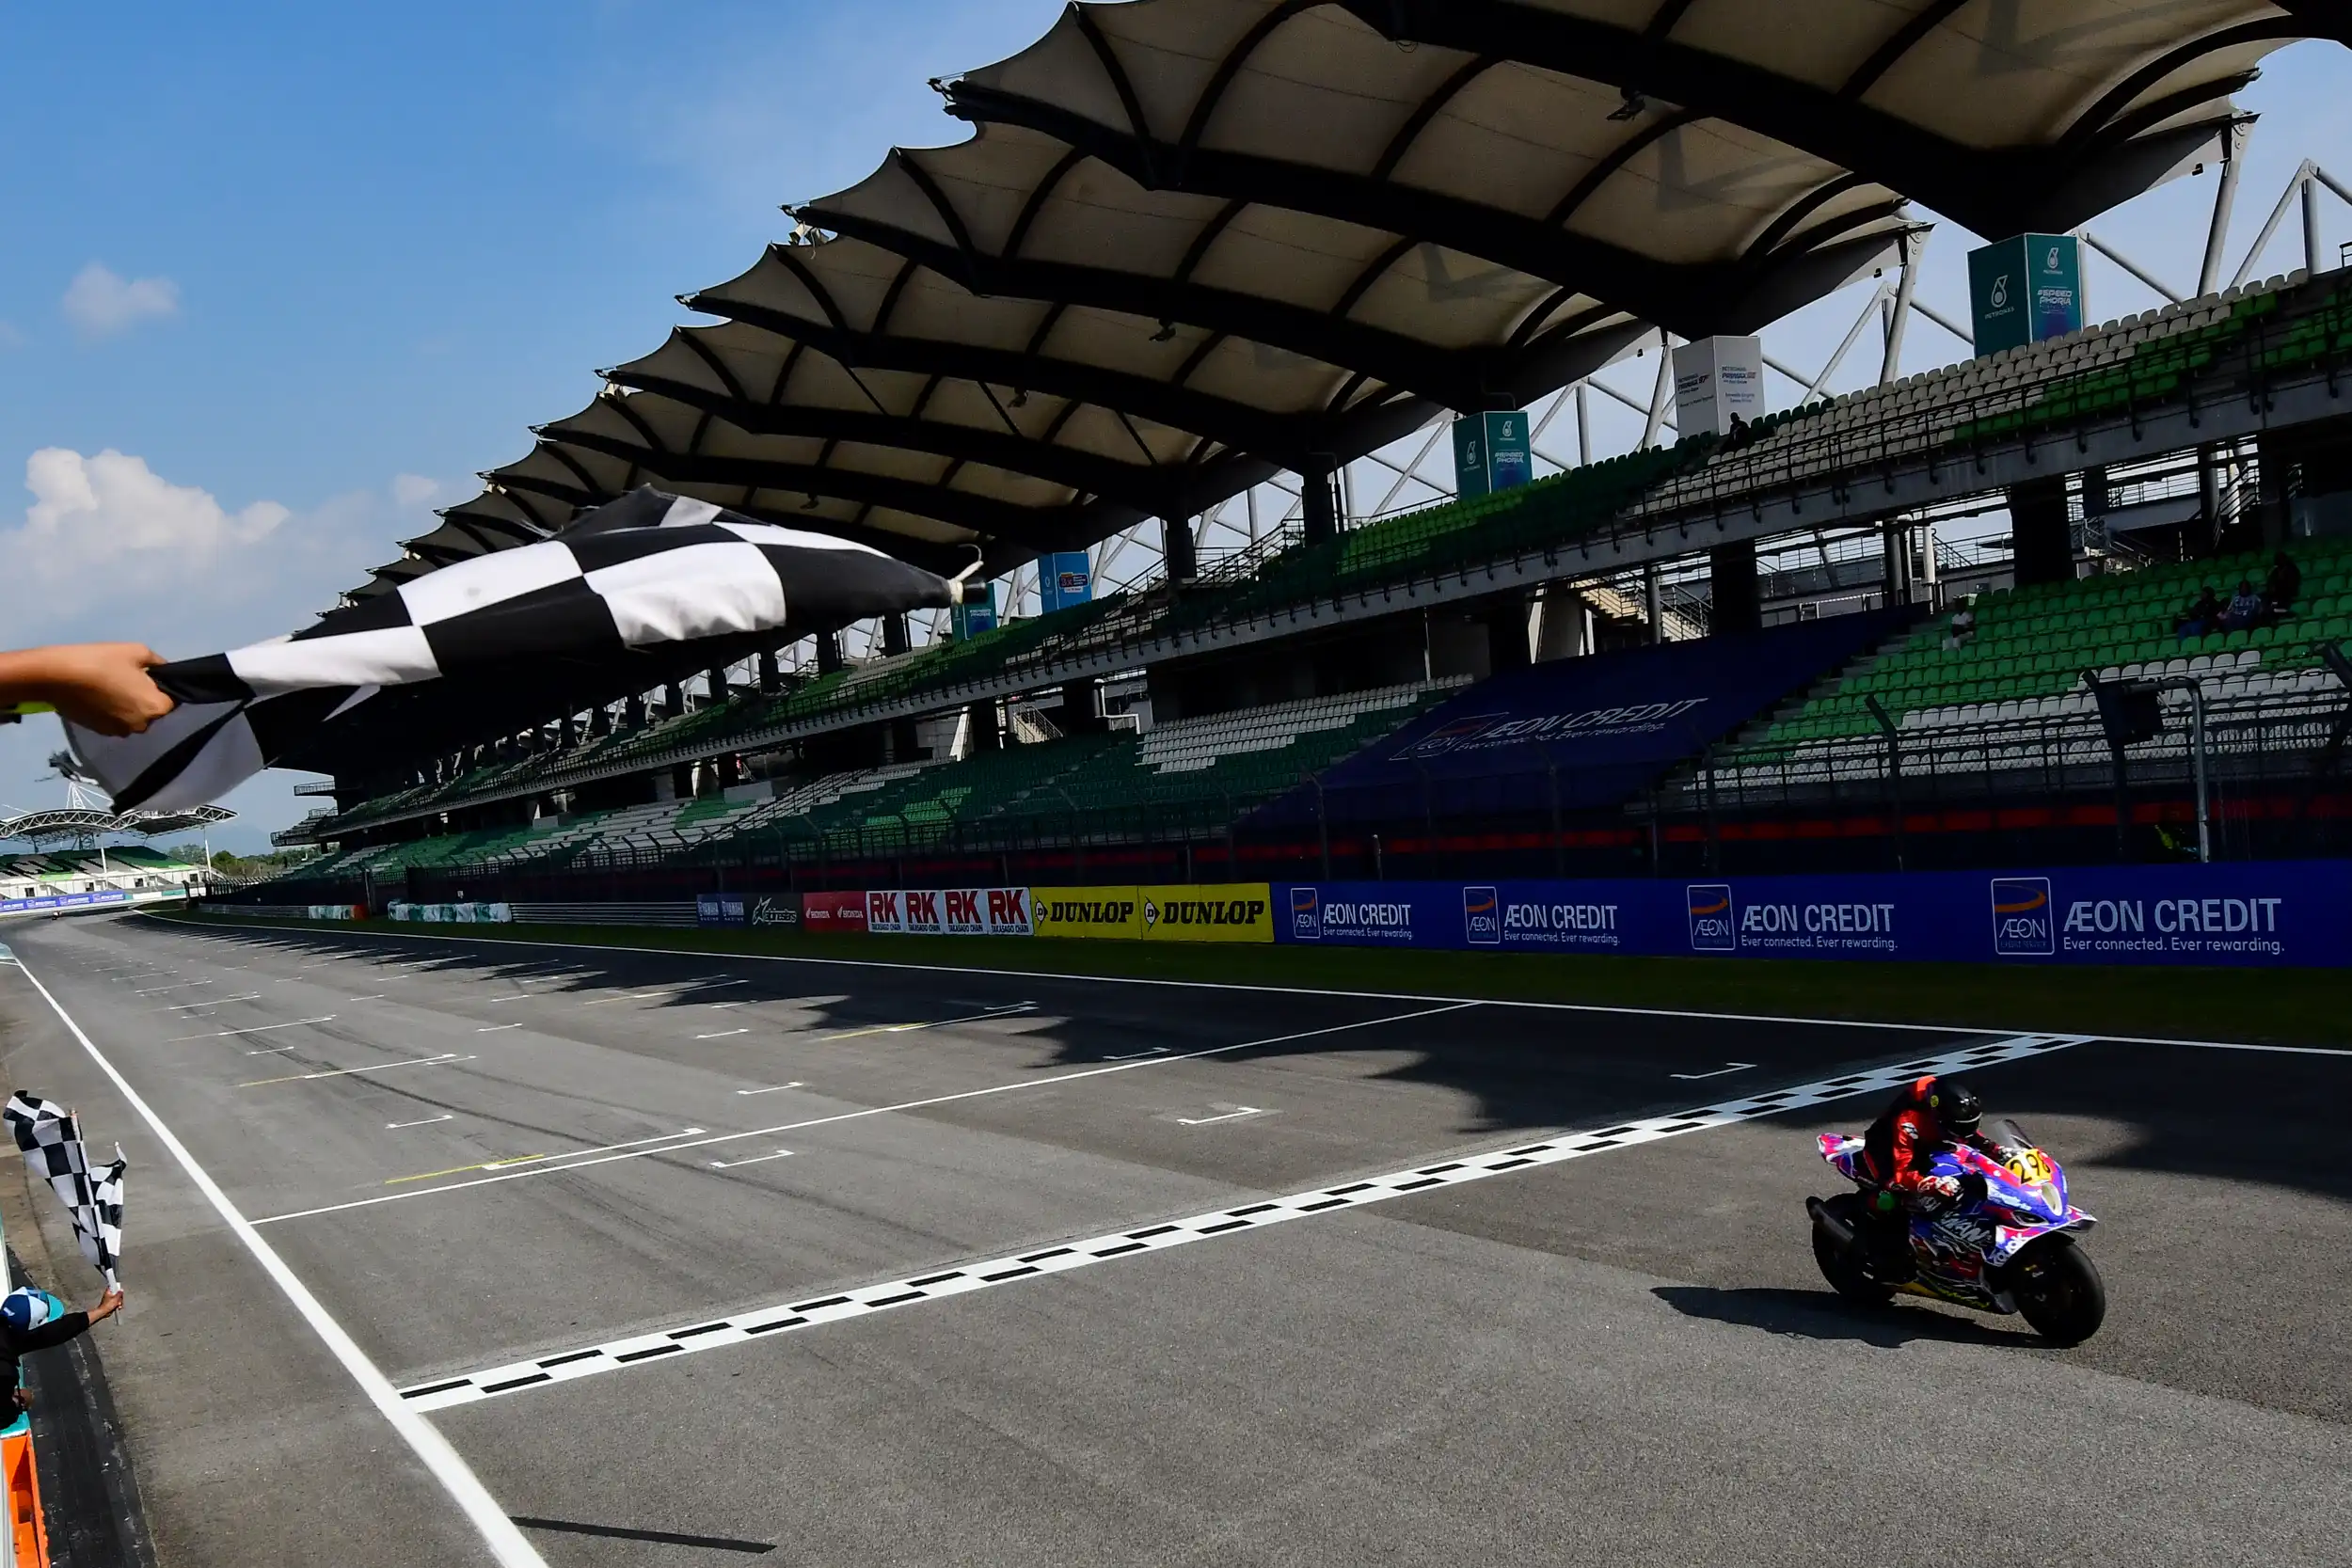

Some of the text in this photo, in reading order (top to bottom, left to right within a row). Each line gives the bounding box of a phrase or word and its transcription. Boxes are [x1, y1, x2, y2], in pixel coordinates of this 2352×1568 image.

[1984, 306, 2015, 320] PETRONAS
[1563, 697, 1709, 730] CREDIT
[842, 910, 864, 919] HONDA
[869, 893, 900, 923] RK
[905, 892, 940, 924] RK
[945, 890, 982, 924] RK
[987, 890, 1028, 925] RK
[1050, 901, 1134, 923] DUNLOP
[1163, 900, 1264, 925] DUNLOP
[1323, 903, 1411, 927] ÆON CREDIT
[1504, 904, 1618, 930] ÆON CREDIT
[1740, 903, 1895, 933] ÆON CREDIT
[2062, 897, 2282, 933] ÆON CREDIT
[871, 923, 901, 931] TAKASAGO CHAIN
[908, 924, 941, 932] TAKASAGO CHAIN
[948, 924, 970, 932] TAKASAGO
[991, 925, 1029, 933] TAKASAGO CHAIN
[1323, 927, 1336, 936] Ever
[1336, 927, 1366, 938] connected.
[1367, 927, 1379, 938] Ever
[1381, 928, 1413, 941] rewarding.
[1504, 930, 1519, 941] Ever
[1521, 931, 1561, 942] connected.
[1561, 931, 1577, 943] Ever
[1579, 932, 1621, 946] rewarding.
[1740, 935, 1761, 947] Ever
[1763, 935, 1814, 948] connected.
[1816, 936, 1839, 949] Ever
[1841, 936, 1899, 952] rewarding.
[2063, 937, 2285, 956] Ever connected. Ever rewarding.
